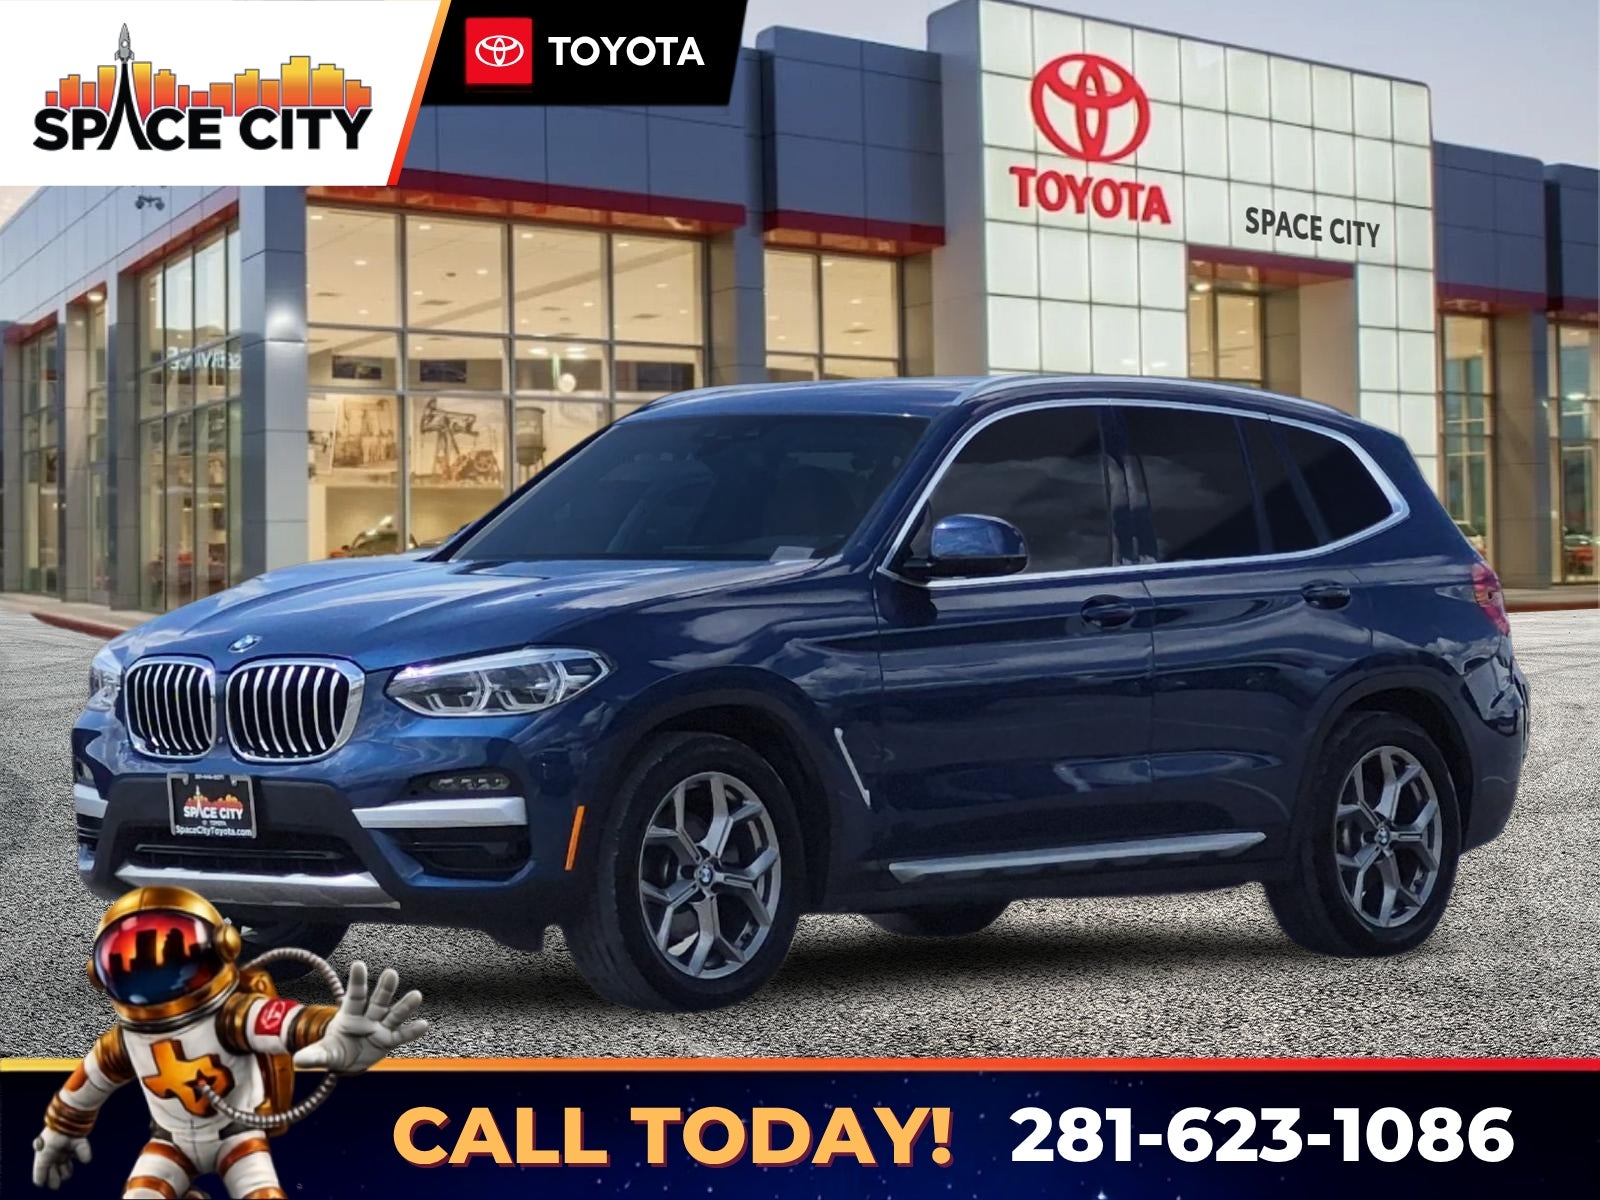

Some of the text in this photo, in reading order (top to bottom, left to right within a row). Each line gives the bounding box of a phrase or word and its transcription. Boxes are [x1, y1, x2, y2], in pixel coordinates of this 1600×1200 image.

[1009, 165, 1171, 225] TOYOTA
[1244, 206, 1381, 248] SPACE CITY
[183, 805, 243, 820] SPACE CITY
[175, 824, 253, 836] SpaceCityToyota.com
